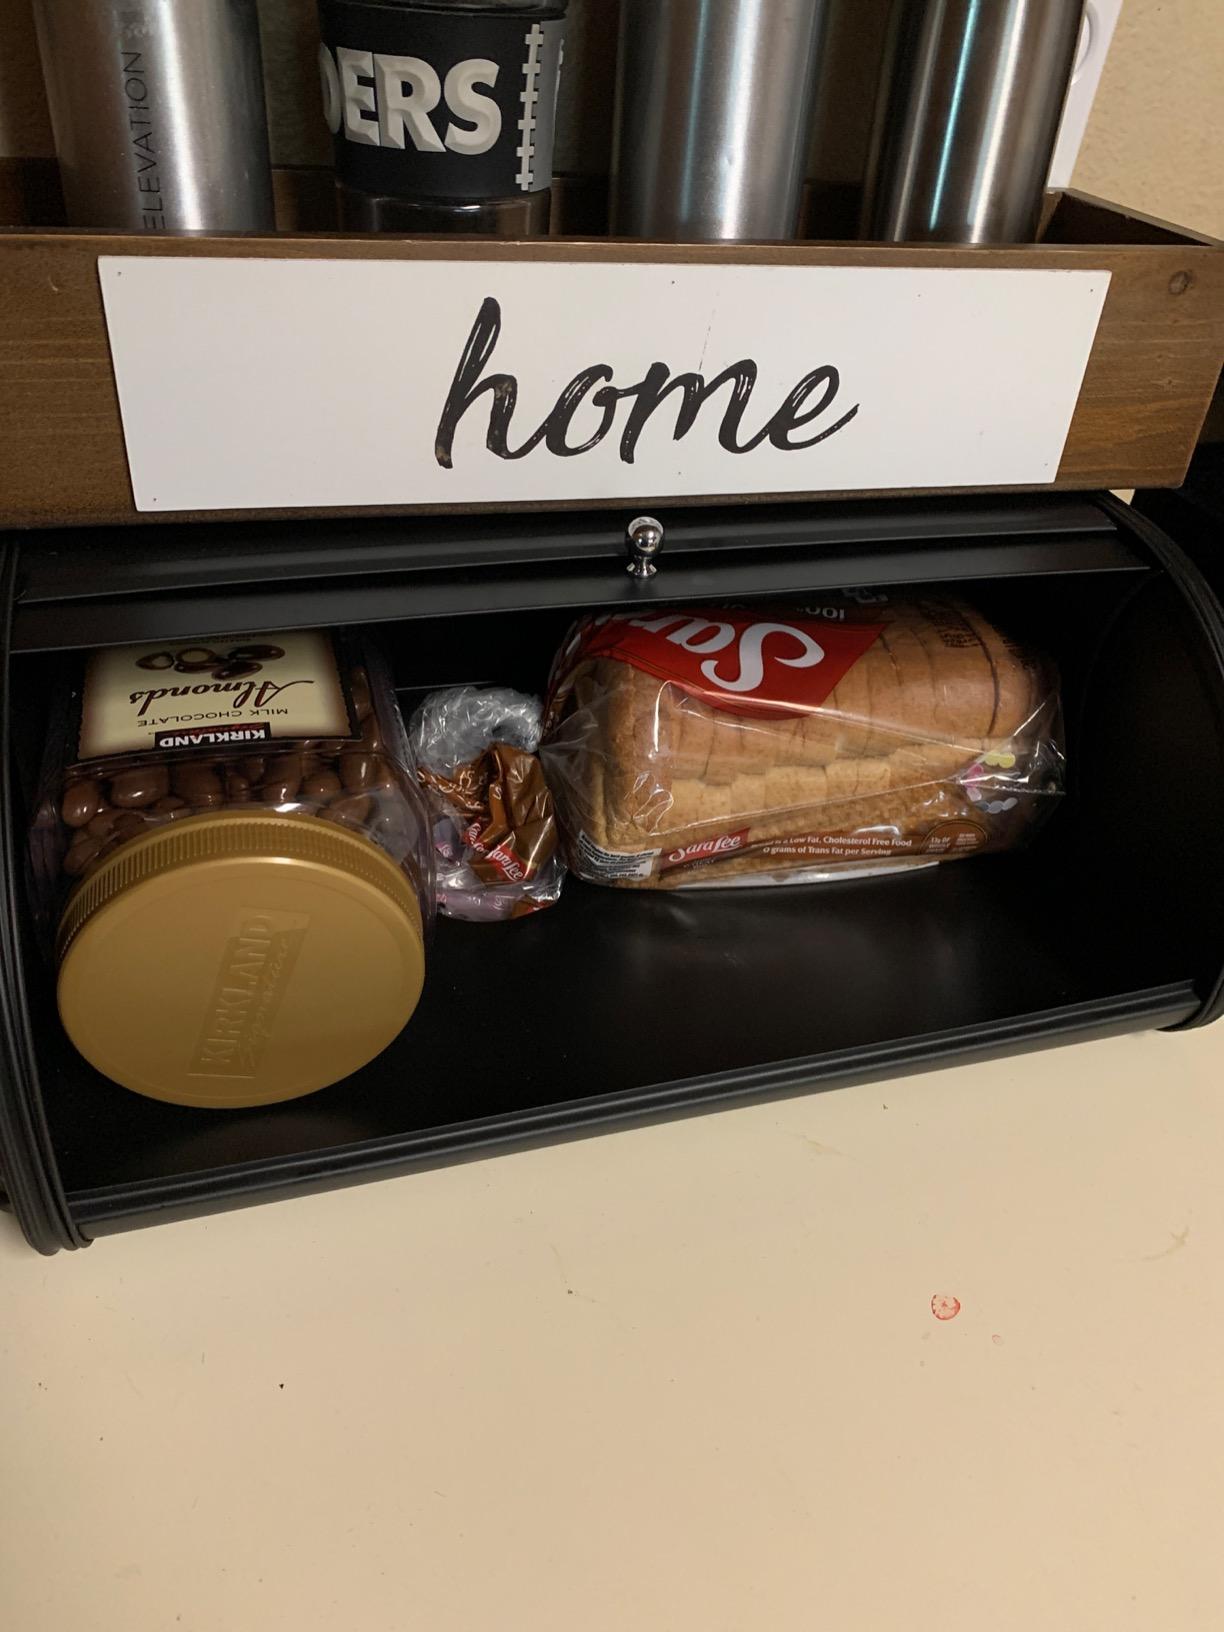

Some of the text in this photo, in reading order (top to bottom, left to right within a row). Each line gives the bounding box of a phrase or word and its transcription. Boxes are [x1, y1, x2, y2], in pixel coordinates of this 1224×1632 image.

[435, 297, 859, 470] home
[129, 679, 314, 717] Almonds
[137, 707, 288, 728] MILK CHOCOLATE
[159, 728, 266, 748] KIRKLAND
[770, 846, 796, 855] grams
[797, 846, 806, 854] of
[808, 846, 830, 854] Trans
[831, 847, 844, 855] Fat
[844, 848, 860, 856] per
[823, 835, 871, 846] Cholesterol
[872, 838, 890, 846] Free
[891, 839, 912, 847] Food
[199, 914, 273, 1065] KIRKLAND
